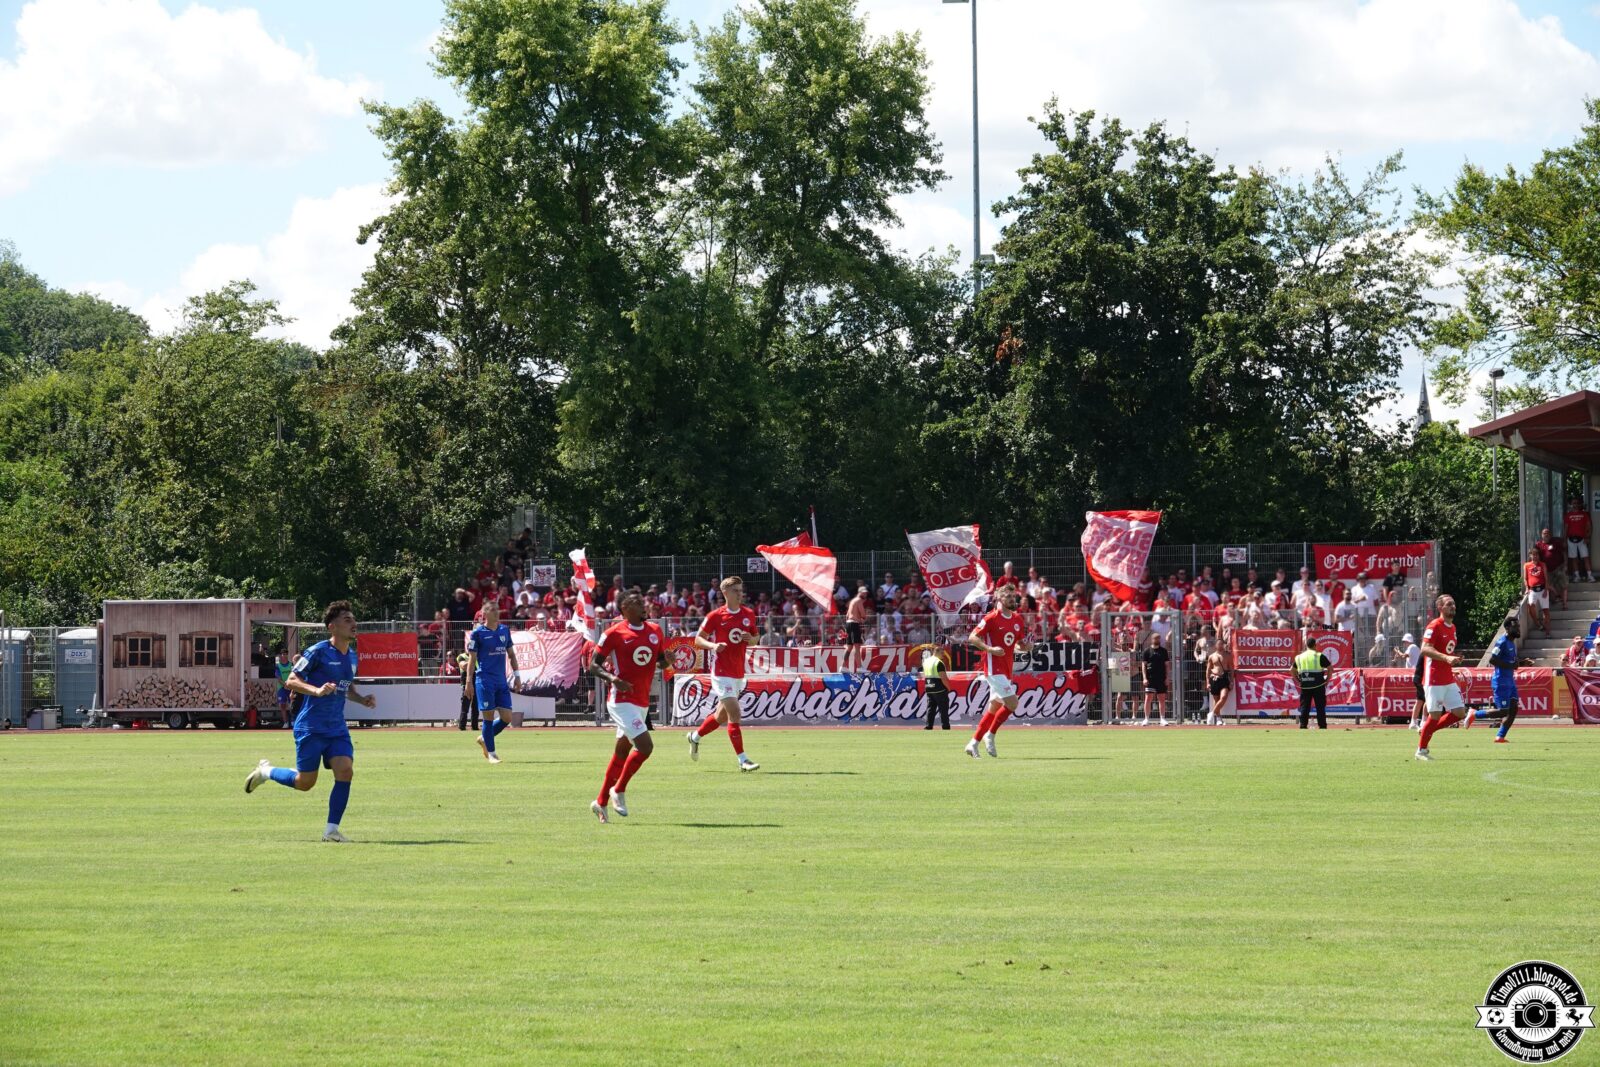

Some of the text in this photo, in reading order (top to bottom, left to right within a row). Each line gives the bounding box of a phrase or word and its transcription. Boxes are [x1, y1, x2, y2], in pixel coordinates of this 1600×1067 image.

[1238, 636, 1293, 648] HORRIDO
[389, 652, 417, 660] Offenbach
[744, 647, 907, 674] KOLLEKTIV 71
[1238, 655, 1292, 667] KICKERS!
